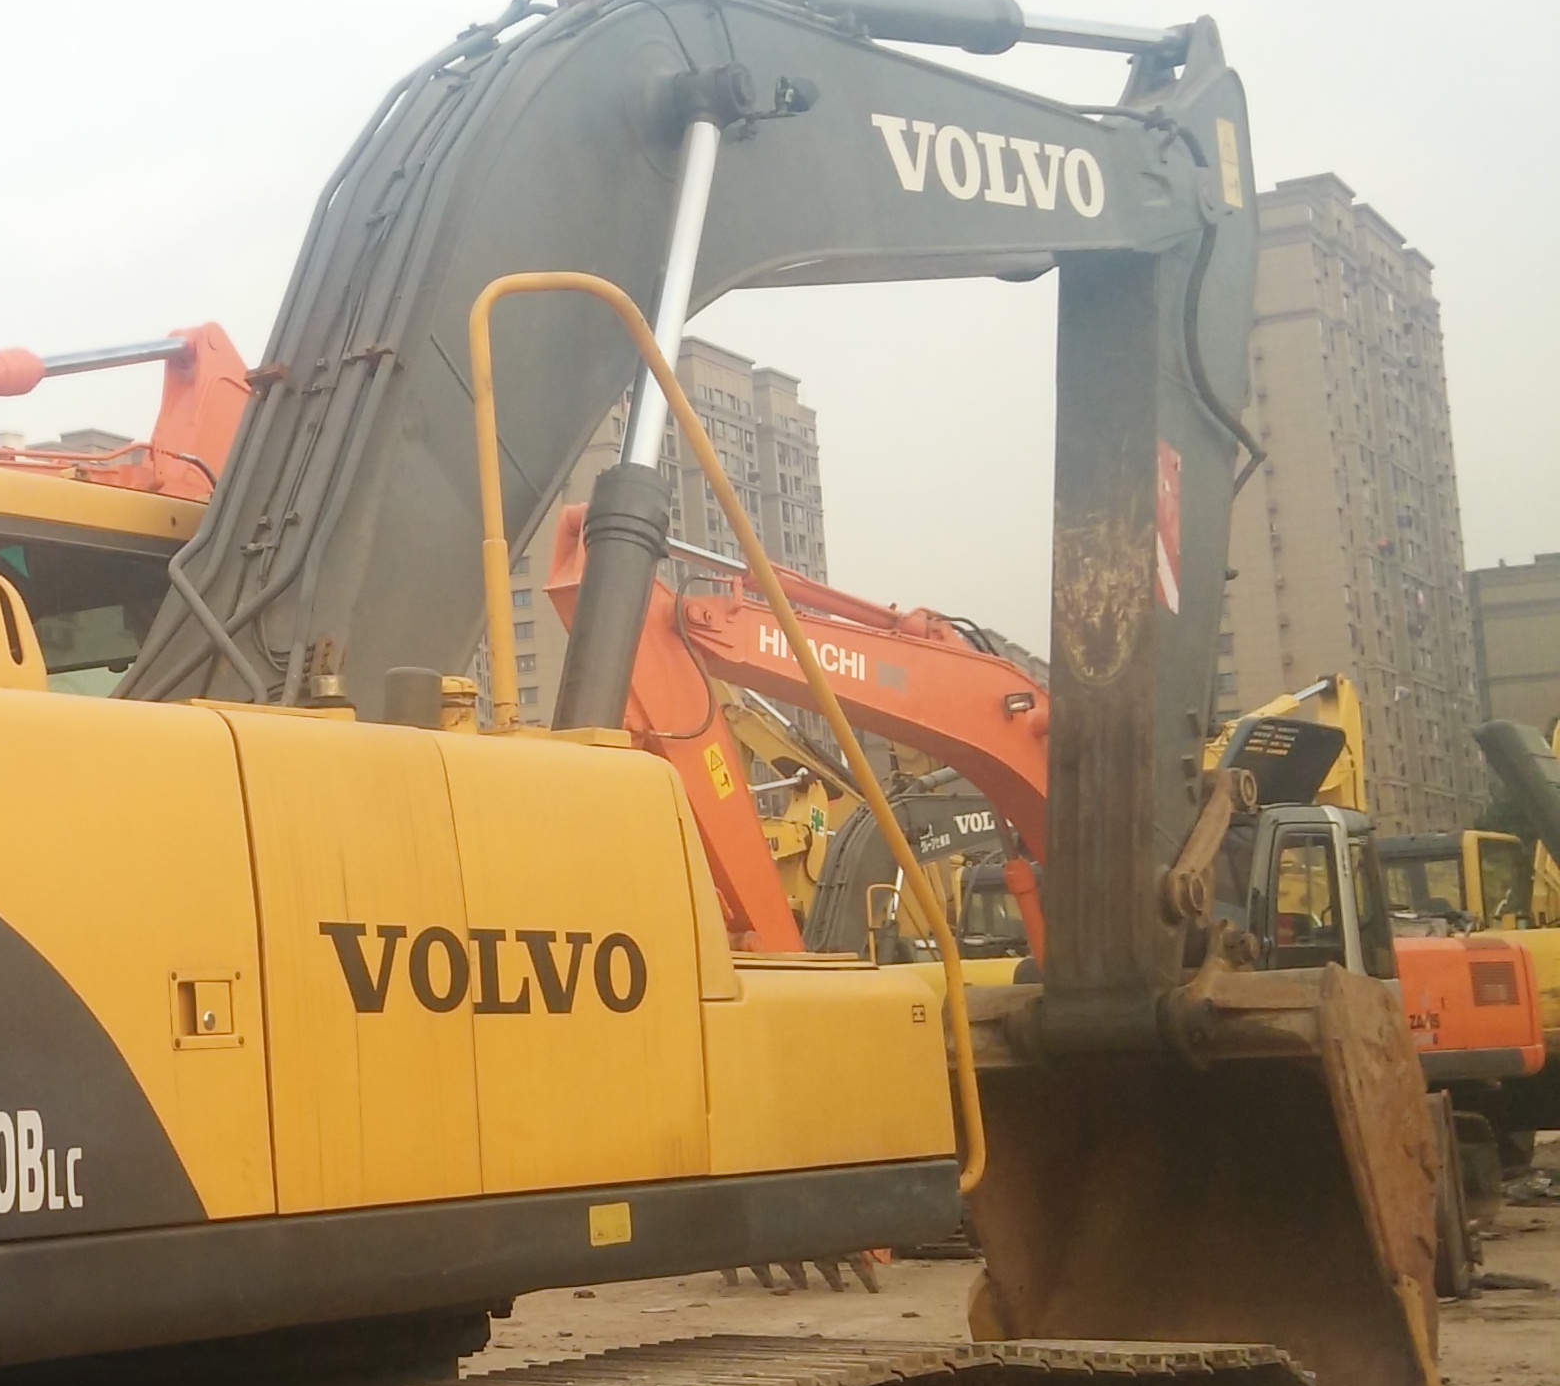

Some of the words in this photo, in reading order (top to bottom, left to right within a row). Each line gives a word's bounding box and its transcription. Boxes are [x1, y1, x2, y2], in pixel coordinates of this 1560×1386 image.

[871, 113, 1105, 217] VOLVO
[759, 625, 866, 681] HICHI
[953, 811, 1014, 835] VOL
[319, 922, 647, 1014] VOLVO
